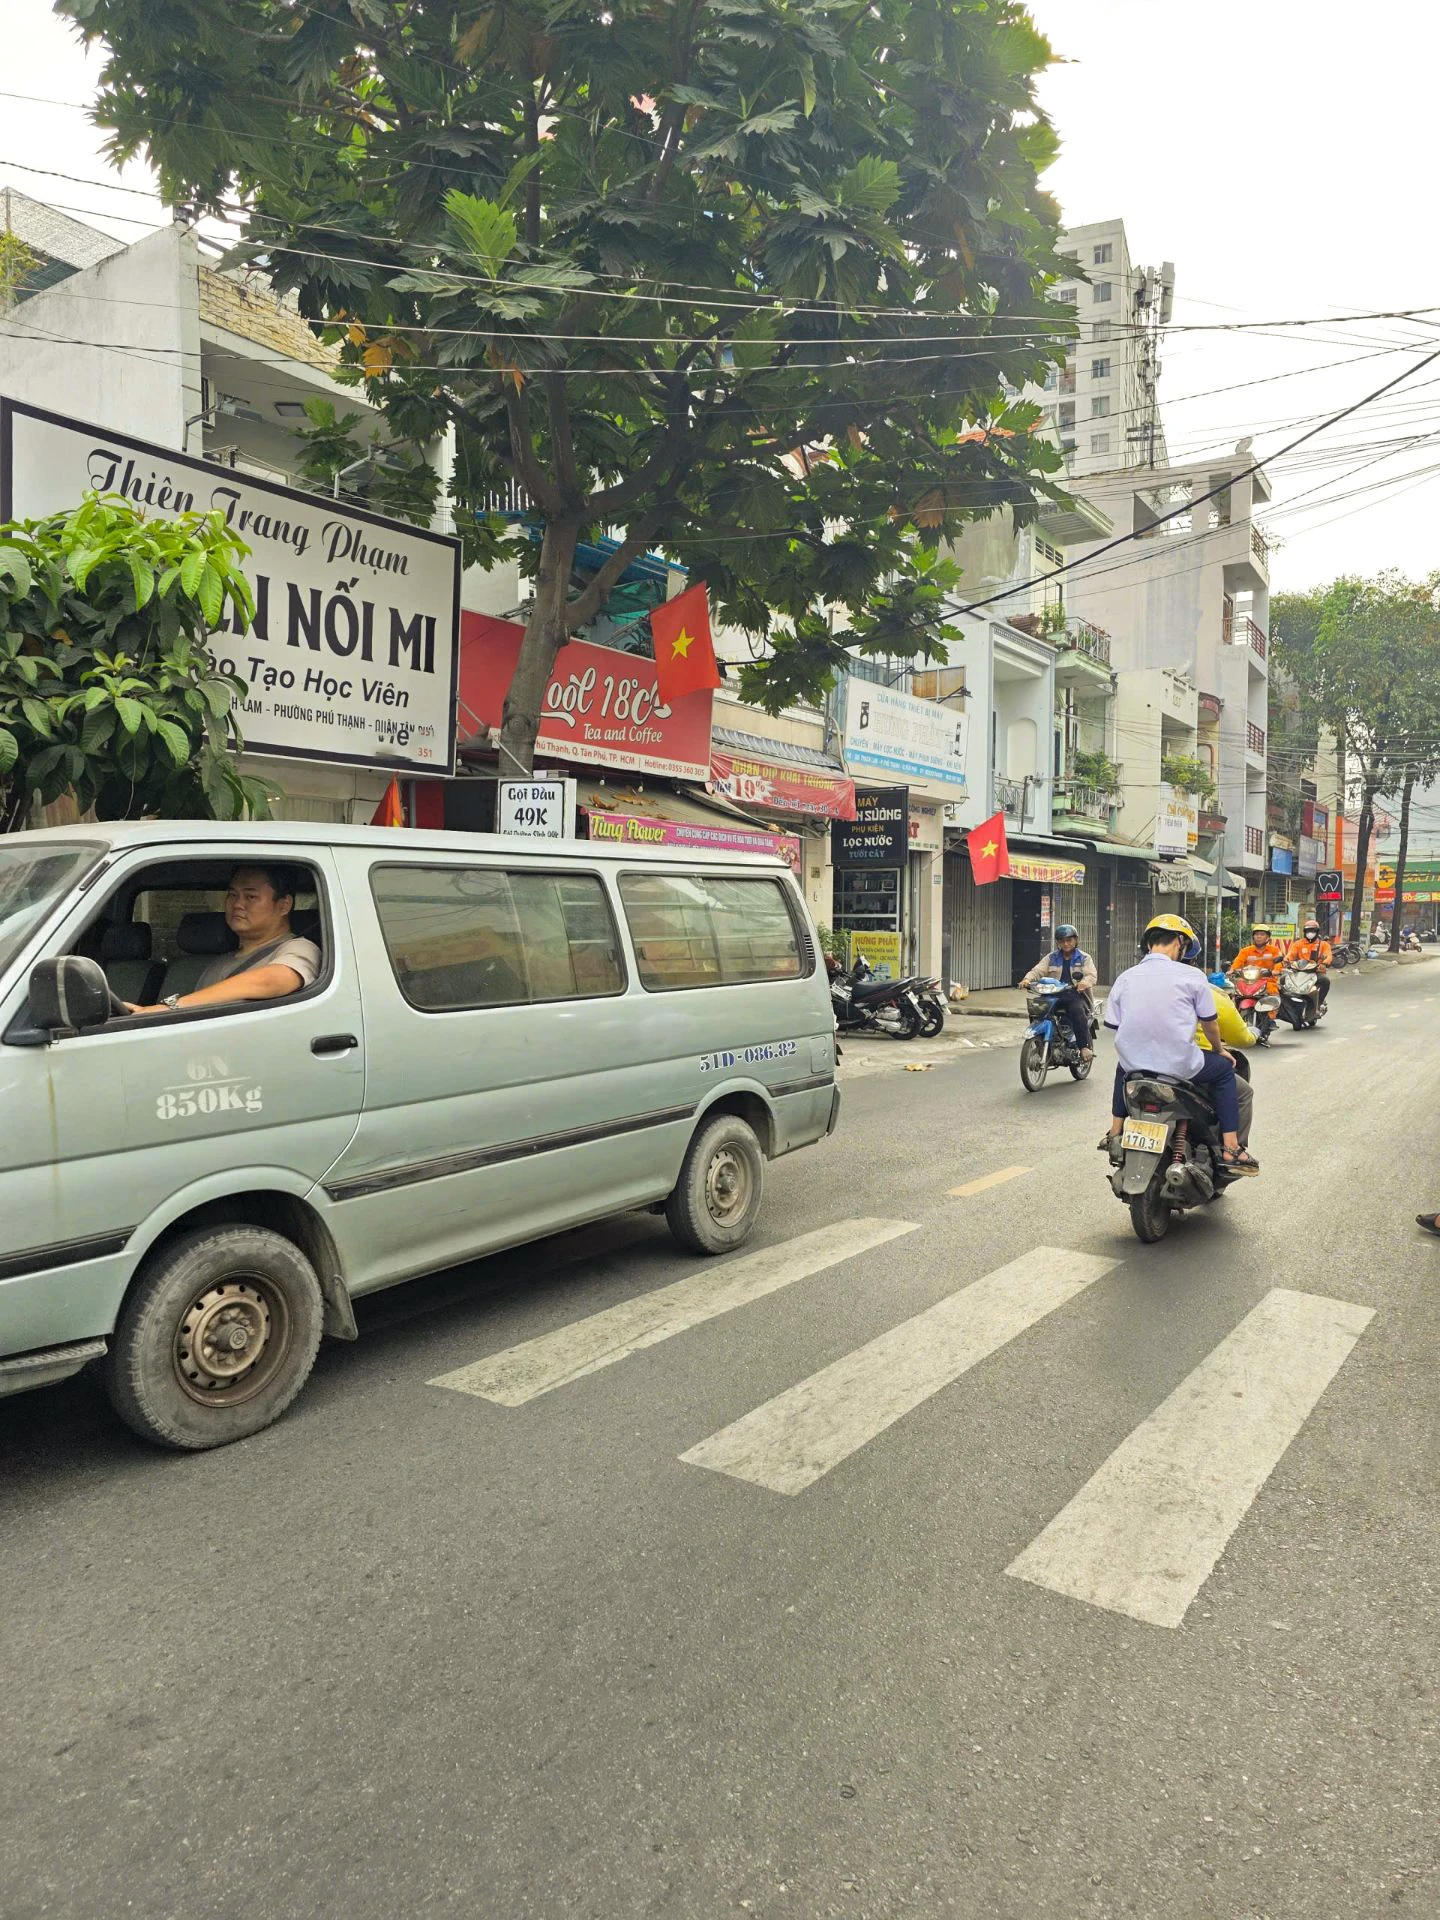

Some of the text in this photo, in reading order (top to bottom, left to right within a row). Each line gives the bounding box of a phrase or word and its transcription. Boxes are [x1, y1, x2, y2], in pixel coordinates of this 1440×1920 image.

[87, 448, 410, 576] Thiên Trang Phạm
[286, 577, 375, 662] NỐI
[388, 607, 437, 674] MI
[247, 656, 296, 692] Tạo
[303, 668, 353, 702] Học
[362, 678, 410, 709] Viên
[273, 703, 313, 722] PHƯỜNG
[315, 709, 335, 726] PHÚ
[337, 713, 366, 731] THẠNH
[583, 723, 664, 744] Tea and Coffee
[620, 755, 635, 764] HCM
[668, 763, 683, 773] 0355
[508, 787, 555, 804] Gội Đầu
[514, 807, 548, 827] 49K
[627, 818, 667, 842] Flower
[843, 835, 893, 848] LỌC NƯỚC
[700, 1041, 796, 1072] 51D-086.82
[156, 1085, 263, 1120] 850Kg
